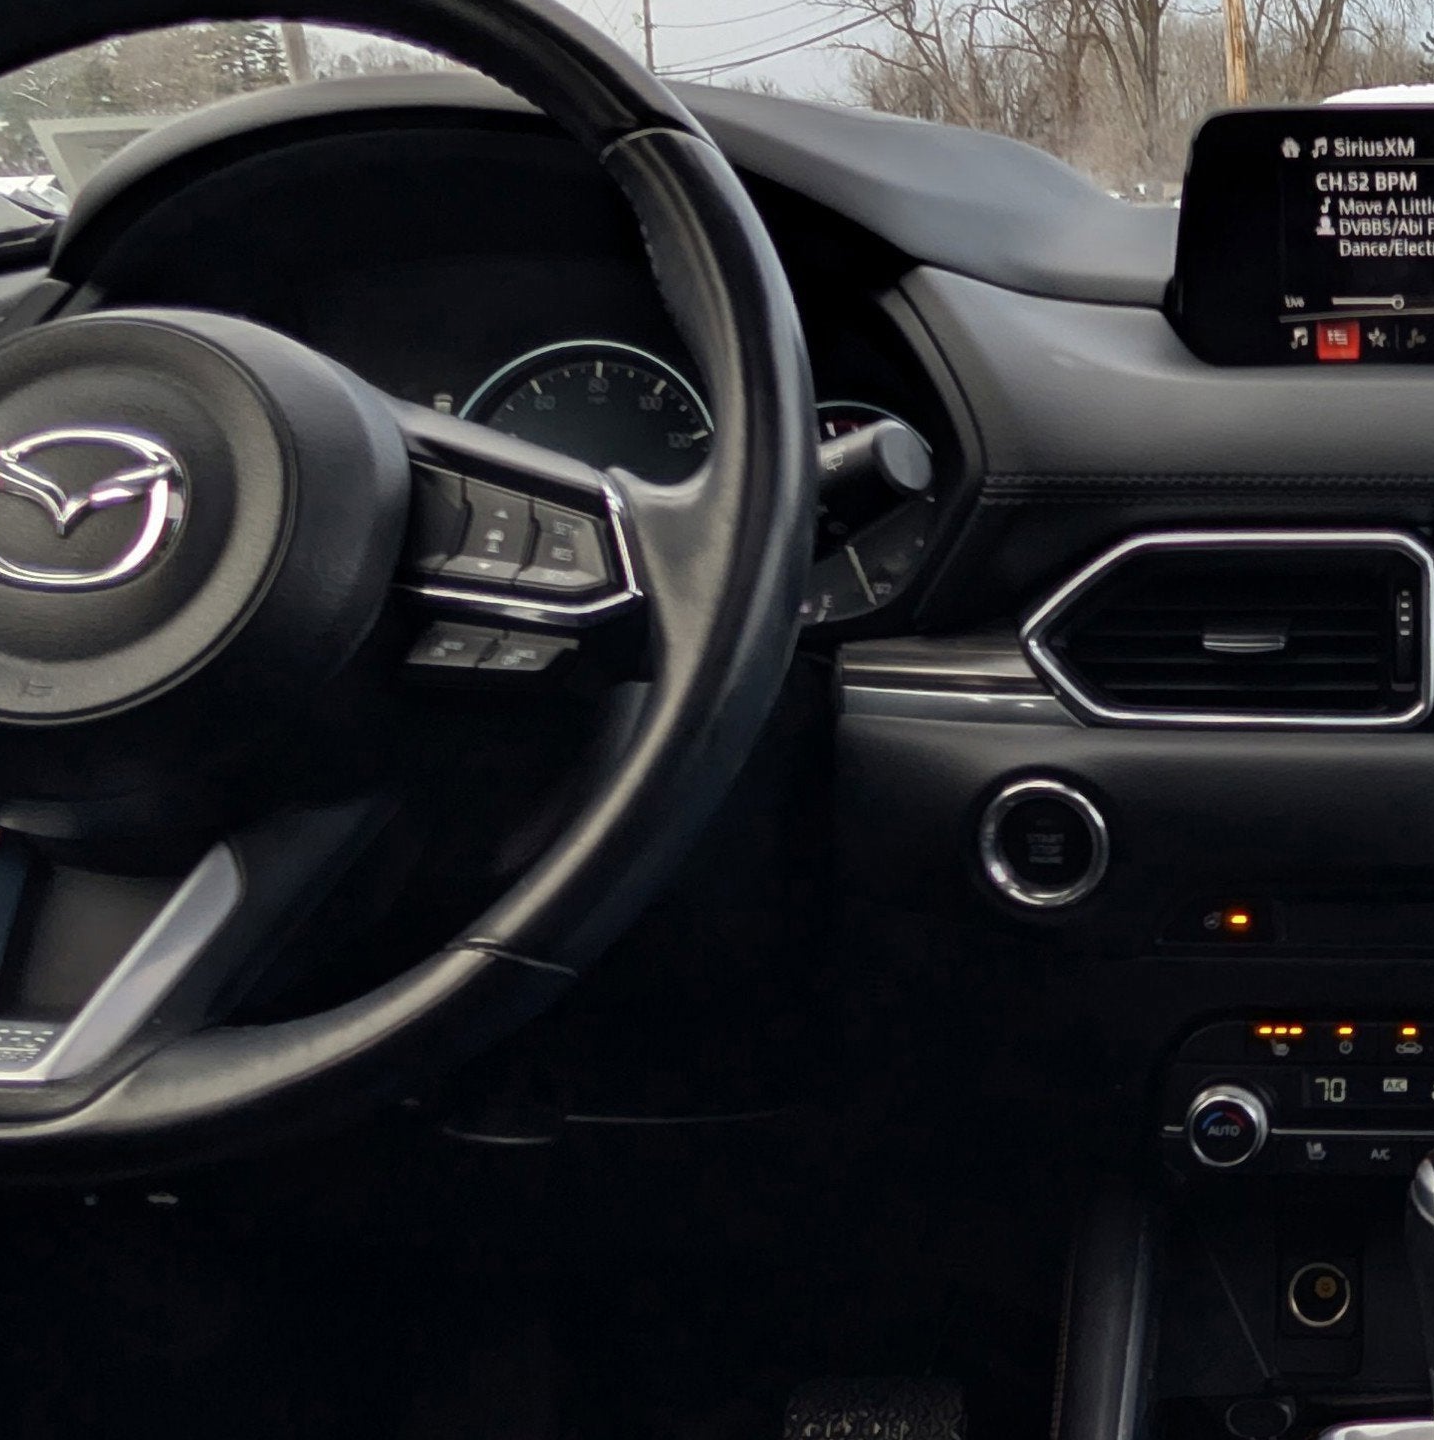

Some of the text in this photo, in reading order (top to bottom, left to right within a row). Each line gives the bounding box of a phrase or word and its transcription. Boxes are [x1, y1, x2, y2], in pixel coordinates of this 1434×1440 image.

[1333, 137, 1416, 158] SiriusXM
[1316, 172, 1417, 192] CH.52 BPM
[1339, 197, 1383, 216] Move
[1386, 197, 1398, 215] A
[1339, 217, 1424, 237] DVBBS/Abi
[1315, 1077, 1347, 1102] 70
[1207, 1123, 1241, 1137] AUTO
[1370, 1148, 1391, 1161] A/C
